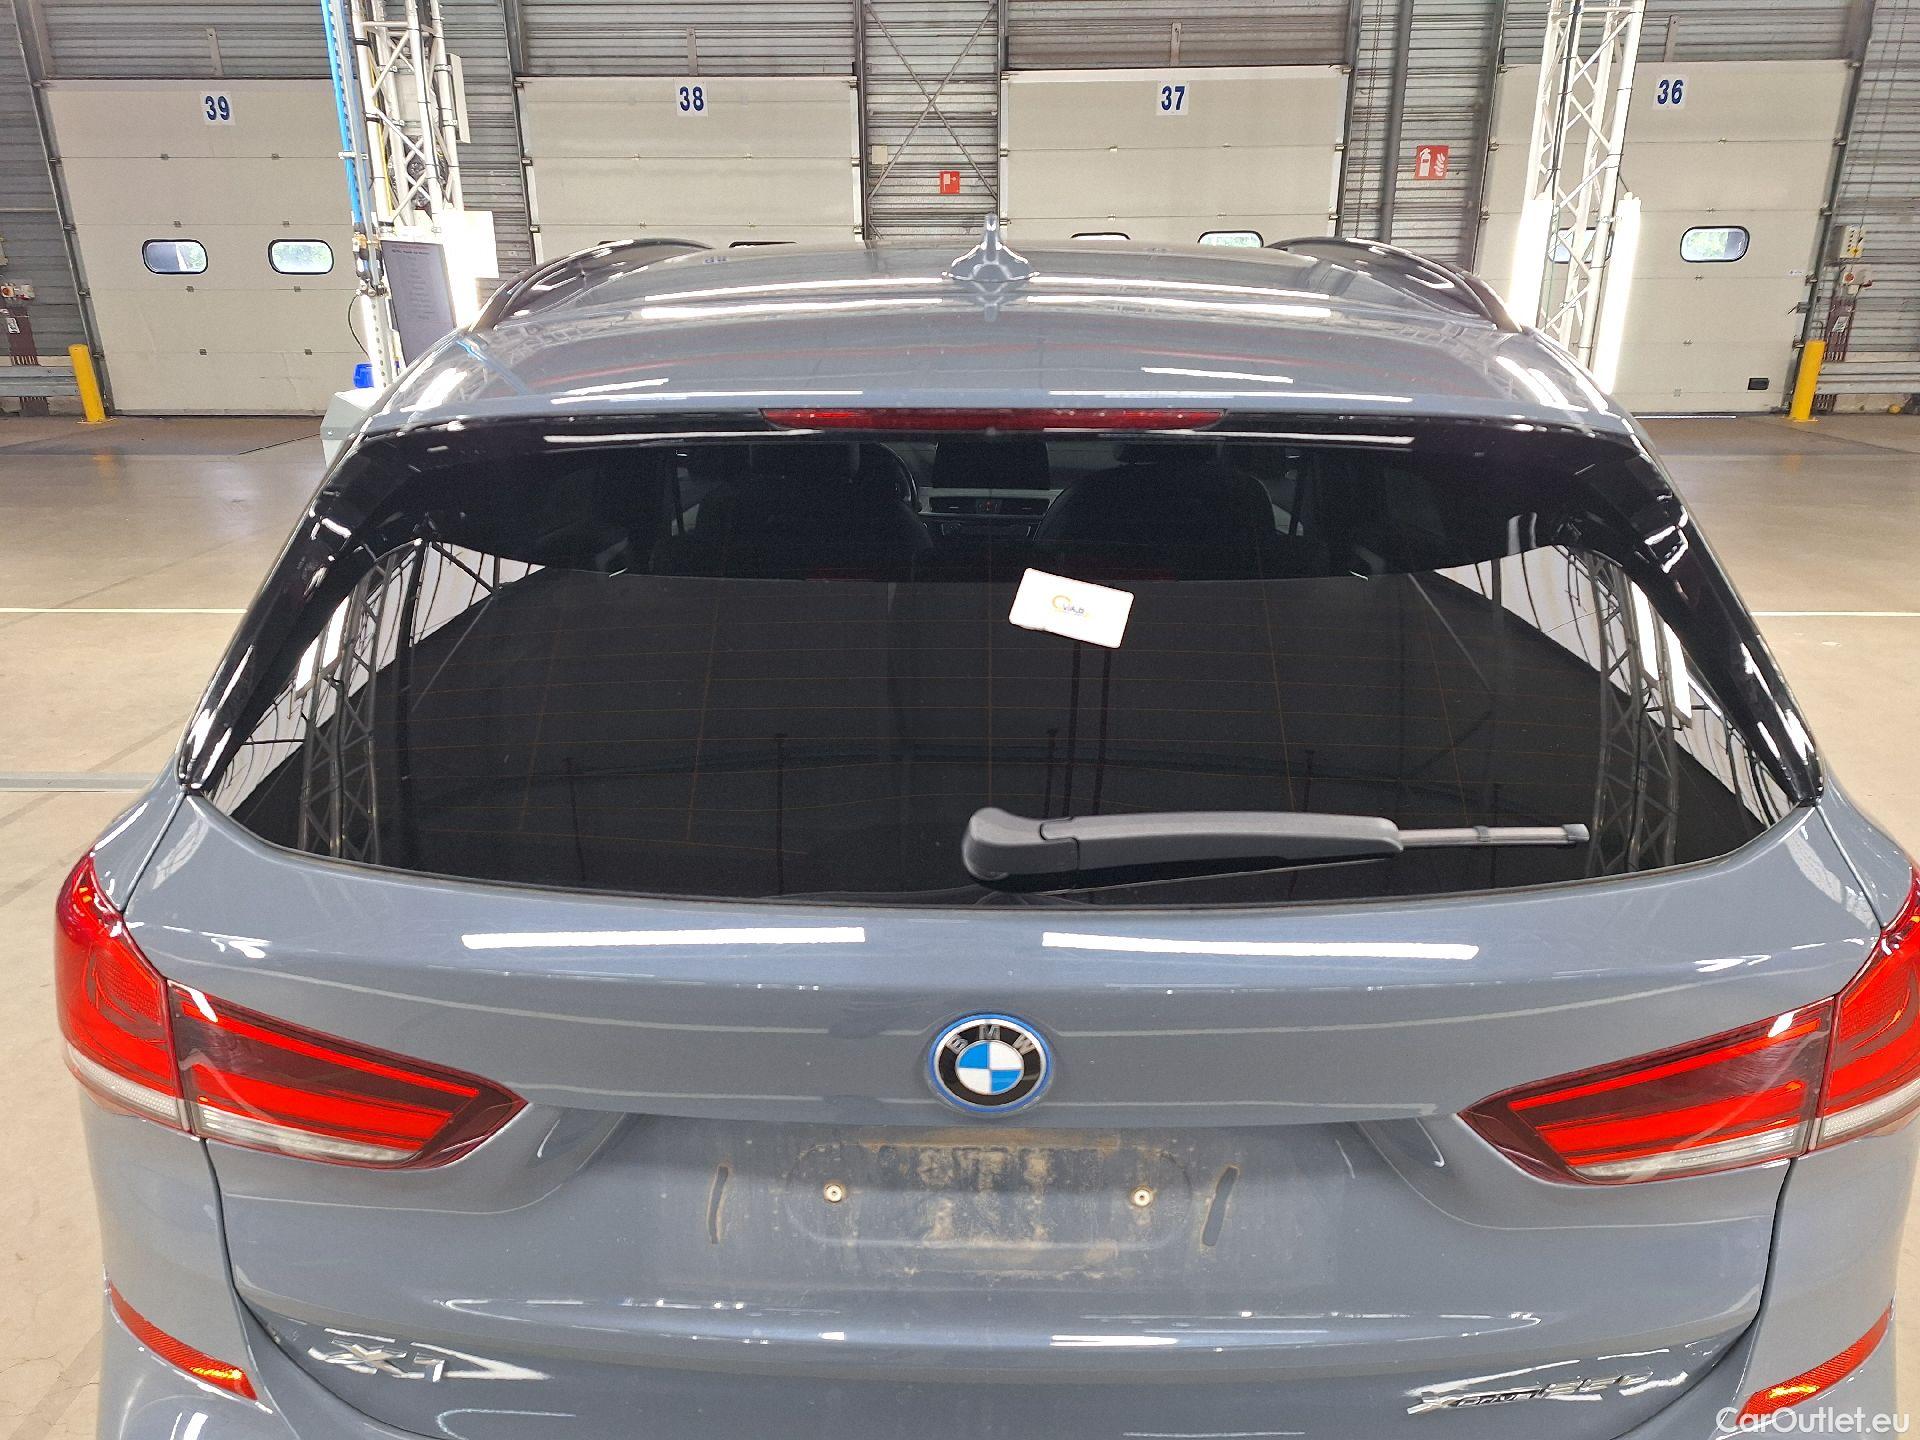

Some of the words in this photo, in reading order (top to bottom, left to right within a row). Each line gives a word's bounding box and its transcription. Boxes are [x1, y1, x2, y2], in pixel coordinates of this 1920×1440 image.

[679, 86, 704, 111] 38
[1161, 85, 1186, 111] 37
[1657, 79, 1684, 105] 36
[205, 95, 230, 121] 39
[945, 1024, 1036, 1055] BMW
[330, 1339, 446, 1383] X1
